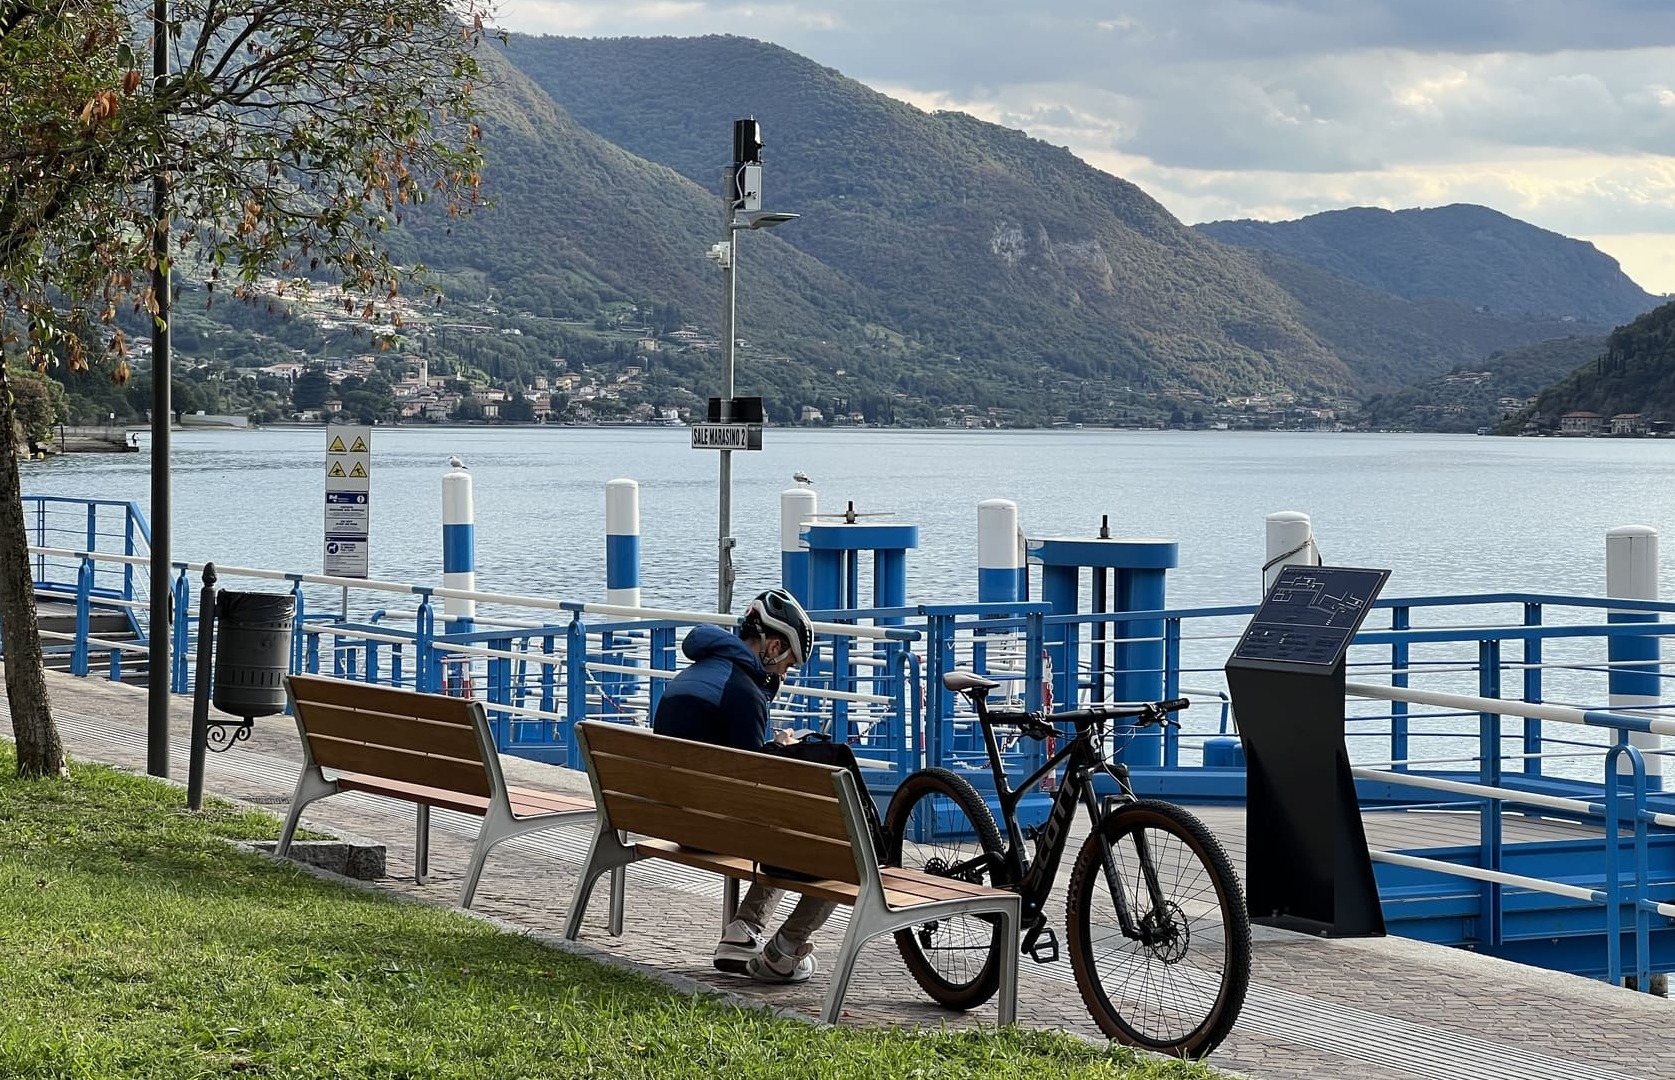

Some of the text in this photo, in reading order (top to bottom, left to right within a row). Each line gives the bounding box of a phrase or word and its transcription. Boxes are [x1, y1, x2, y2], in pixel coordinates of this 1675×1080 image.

[693, 427, 746, 446] SALE MARASINO 2
[1031, 769, 1075, 893] SCOTT
